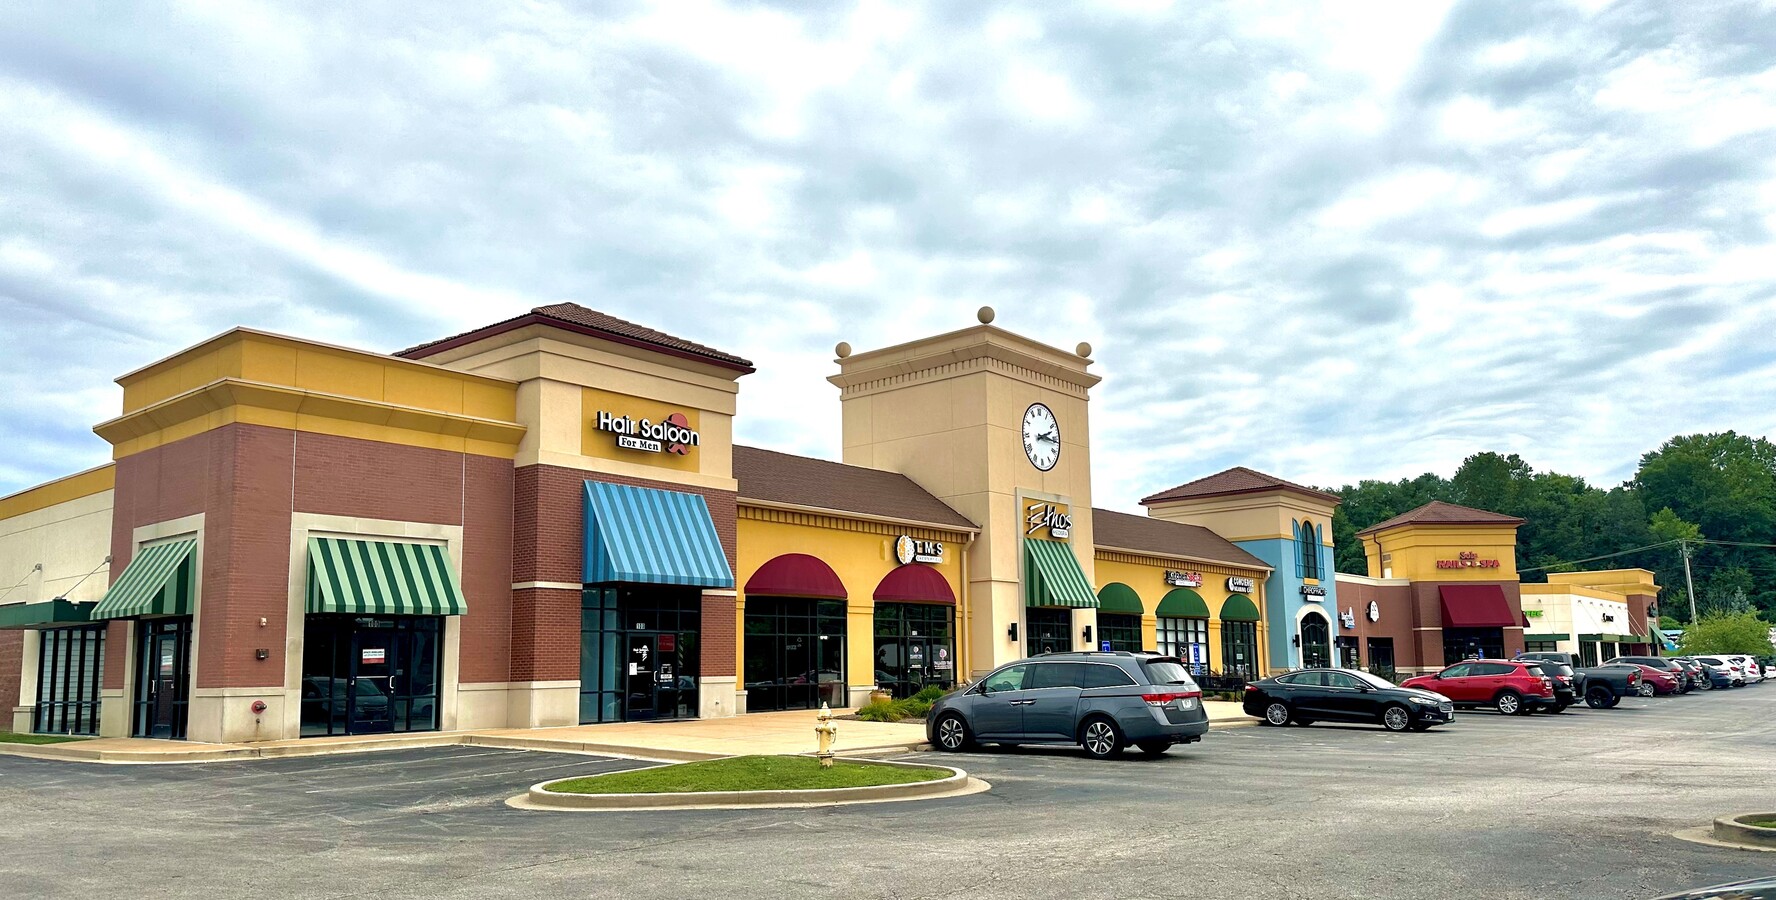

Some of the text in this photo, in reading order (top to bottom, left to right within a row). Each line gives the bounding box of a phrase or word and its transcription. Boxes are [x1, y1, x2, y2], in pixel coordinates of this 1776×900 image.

[597, 410, 700, 446] Hair Saloon
[621, 437, 659, 451] For Men
[1027, 502, 1073, 535] Ethos
[914, 540, 944, 556] TMS
[1437, 560, 1467, 569] NAILS
[1480, 559, 1500, 568] SPA
